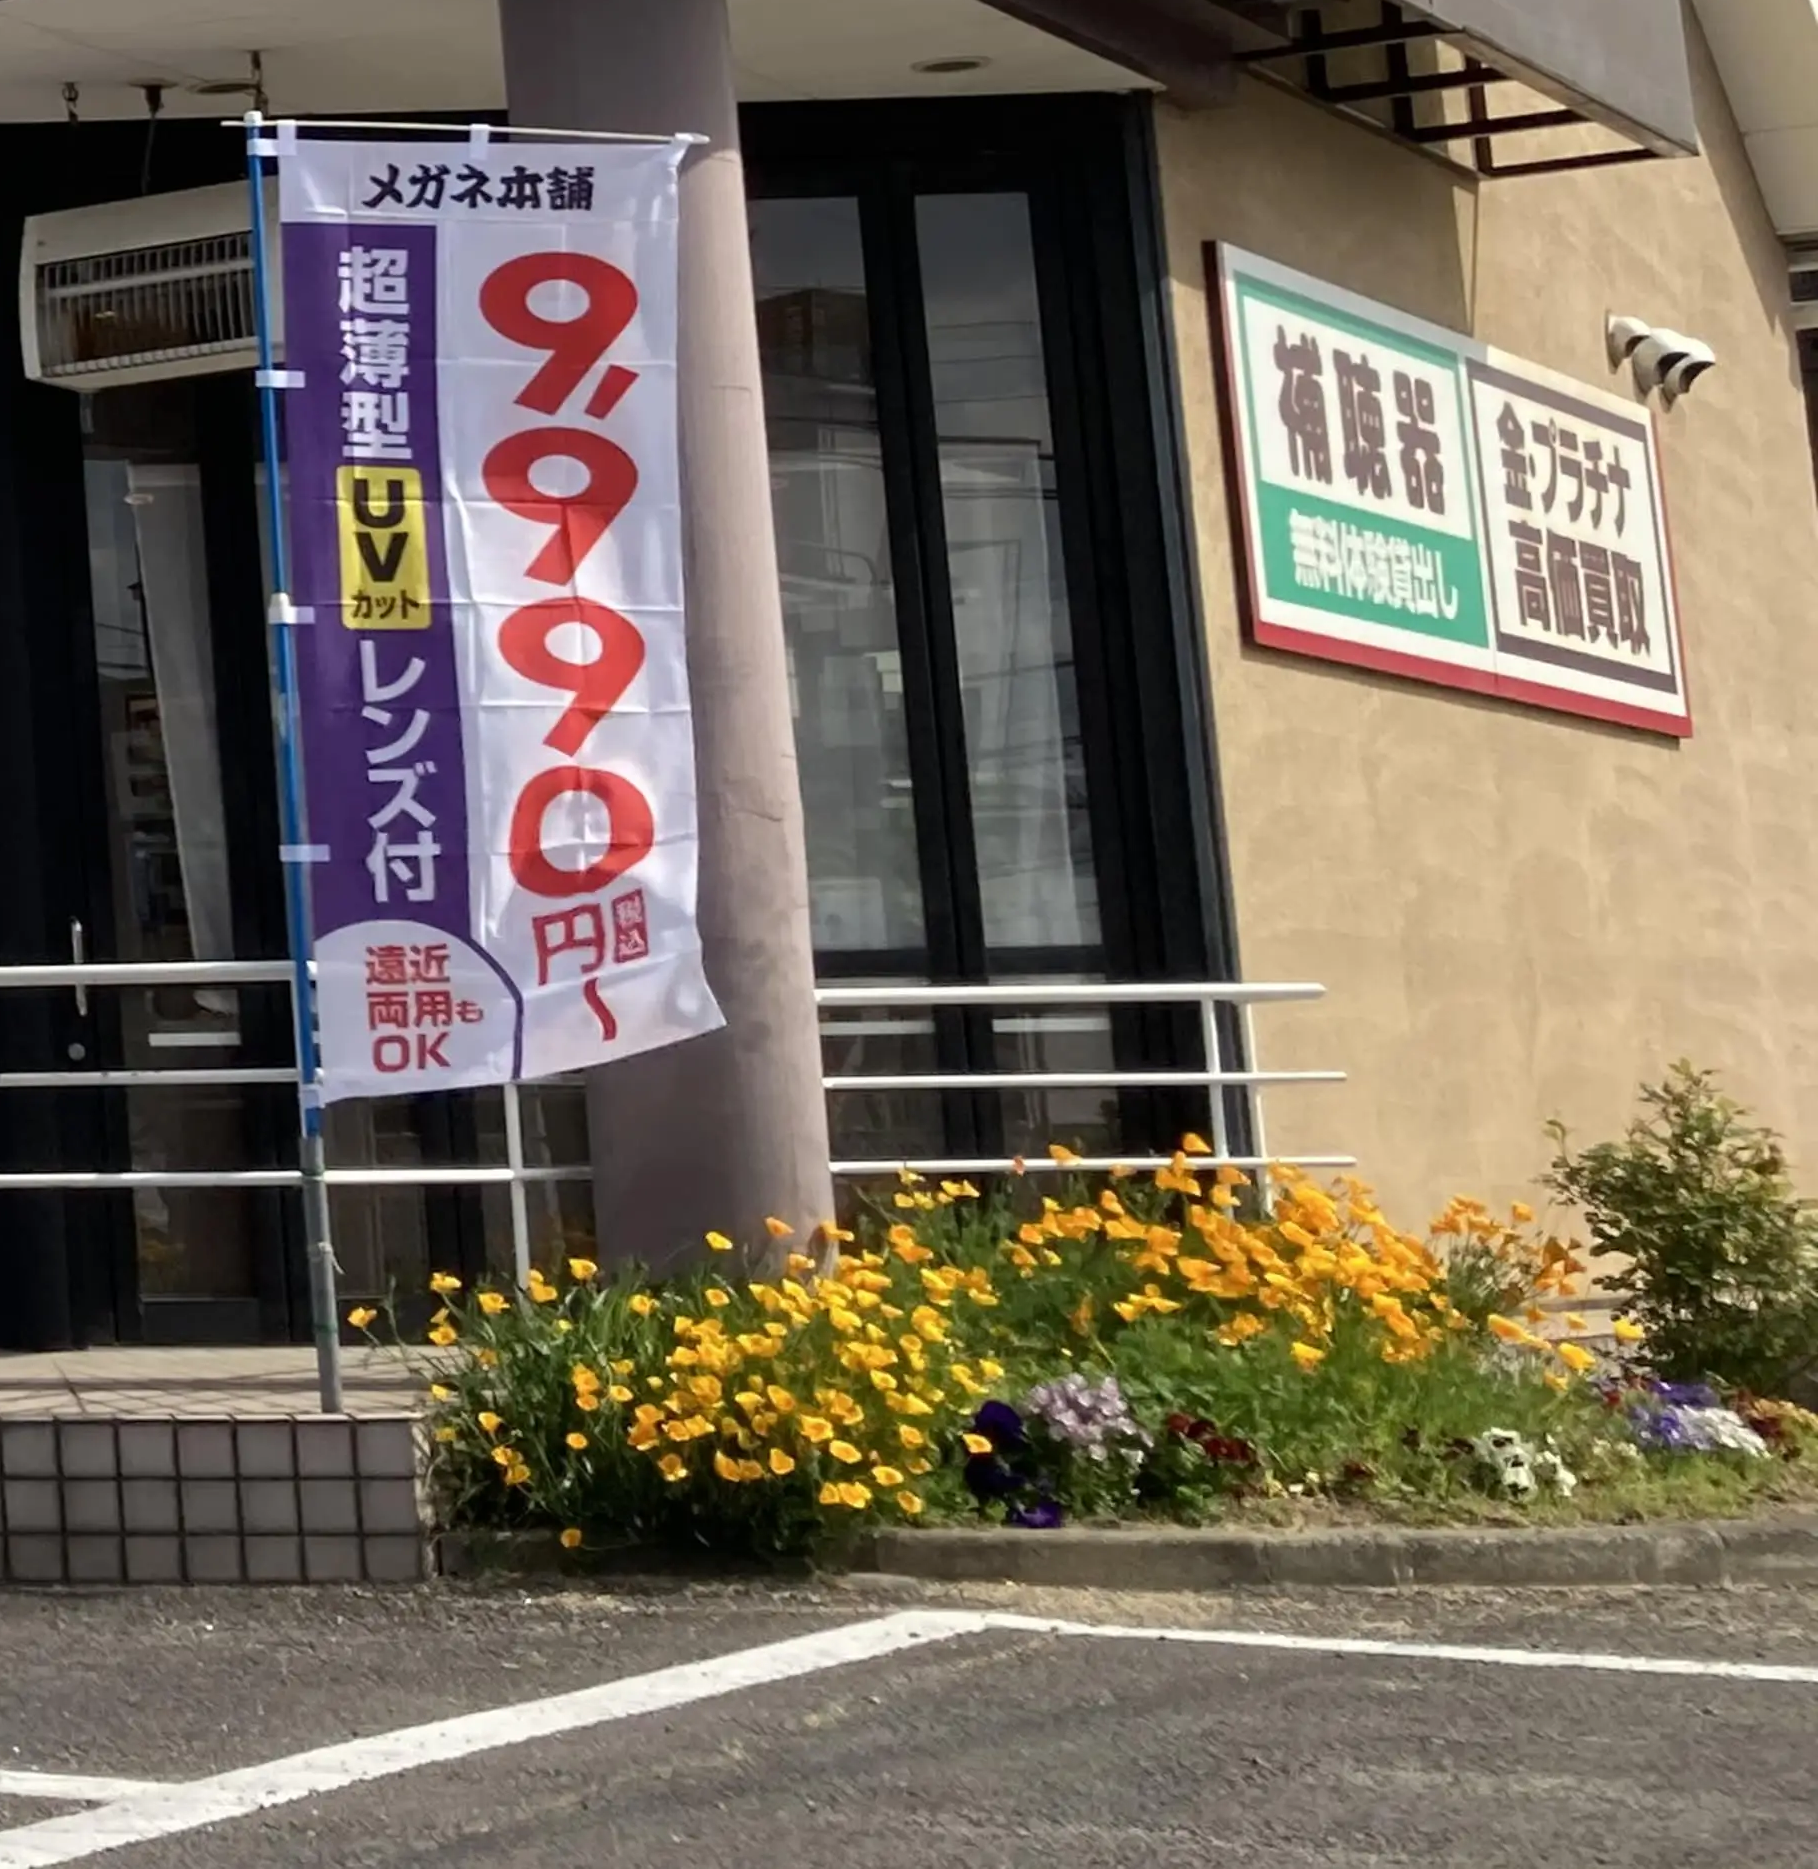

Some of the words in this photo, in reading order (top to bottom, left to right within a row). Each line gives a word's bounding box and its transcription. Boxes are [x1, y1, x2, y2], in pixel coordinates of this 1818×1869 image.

[361, 162, 596, 213] メガネ本舗
[338, 247, 413, 461] 超薄型
[1272, 323, 1446, 516] 補聴器
[352, 478, 408, 583] UV
[1288, 507, 1459, 621] 無料体験貸出し
[349, 588, 420, 621] カット
[1507, 519, 1651, 658] 高価買取
[361, 640, 441, 904] レンズ付
[365, 942, 451, 986] 遠近
[366, 990, 484, 1029] 両用も
[373, 1032, 451, 1074] OK
